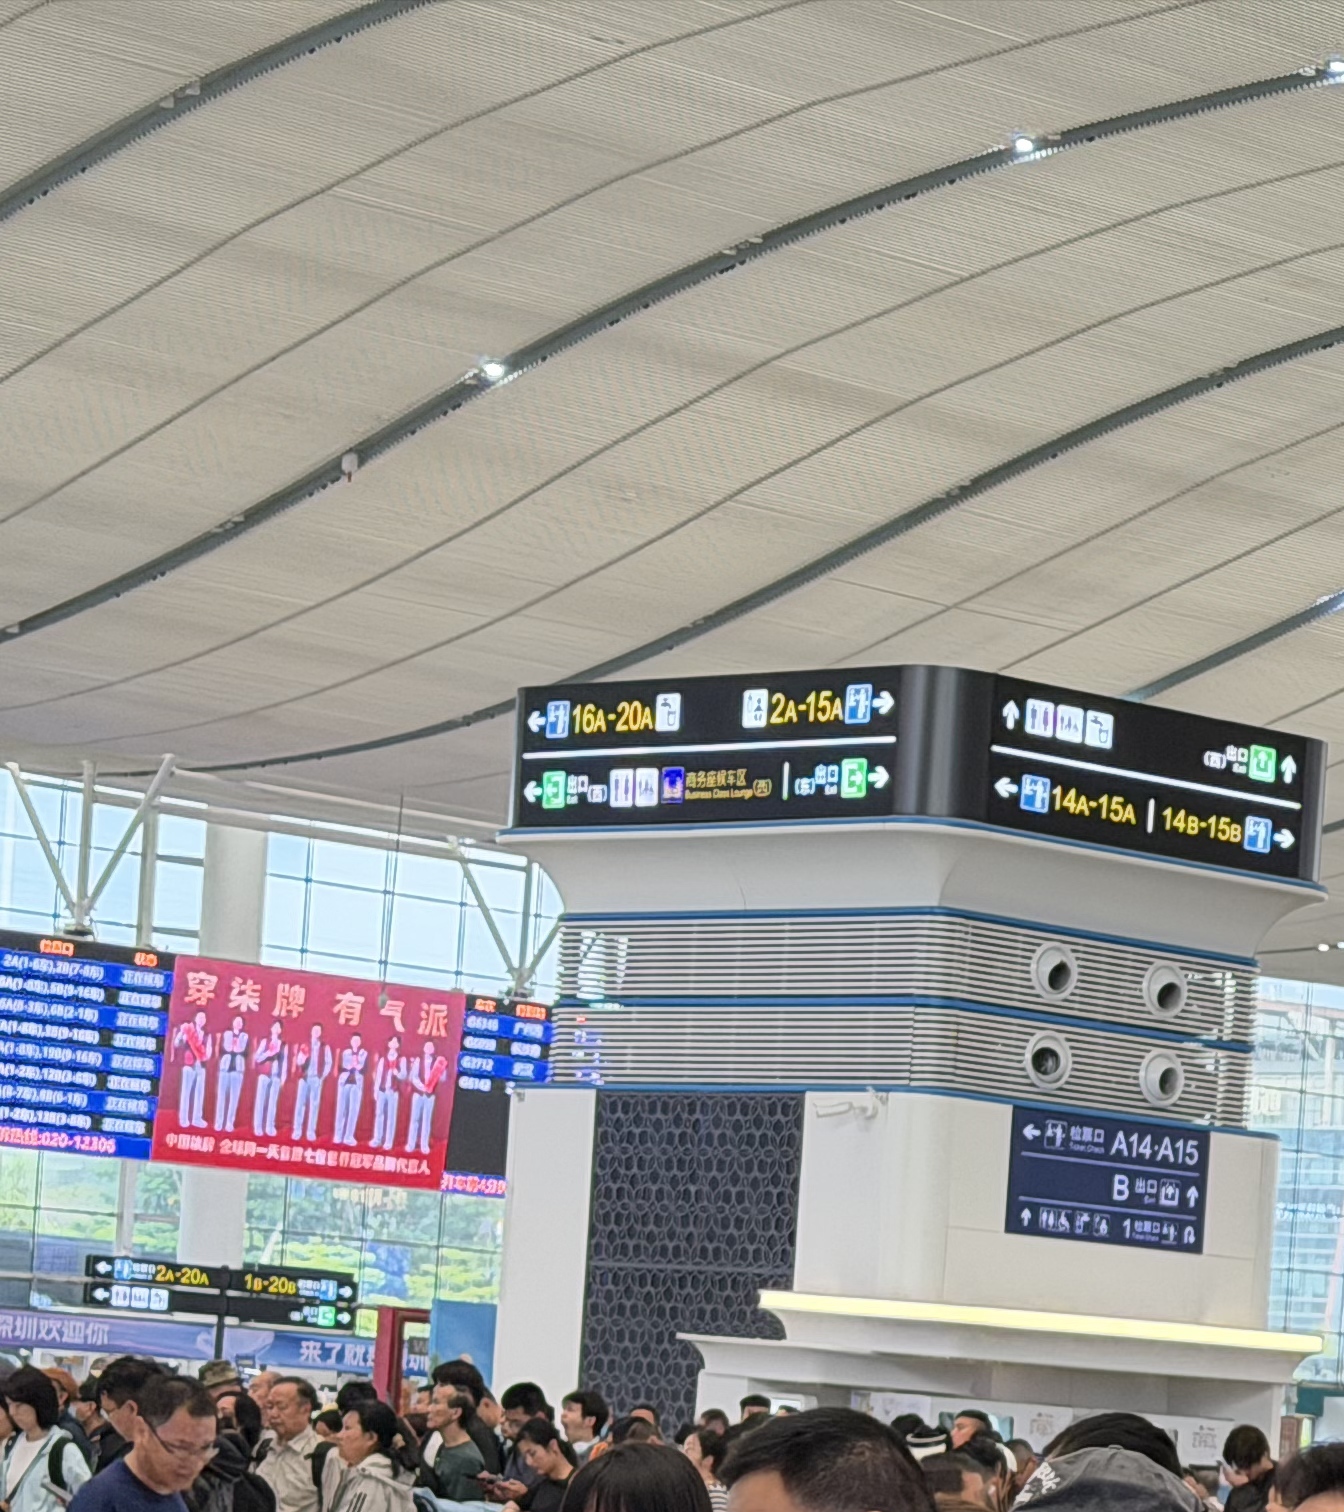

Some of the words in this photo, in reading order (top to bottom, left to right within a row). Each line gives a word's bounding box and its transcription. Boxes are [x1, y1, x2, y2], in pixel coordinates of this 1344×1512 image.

[572, 700, 654, 734] 16A-20A
[769, 690, 844, 724] 2A-15A
[1052, 784, 1136, 825] 14A-15A
[1161, 807, 1242, 843] 14B-15B
[333, 991, 448, 1038] 有气派
[1112, 1174, 1130, 1202] B
[155, 1264, 210, 1286] 2A-20A
